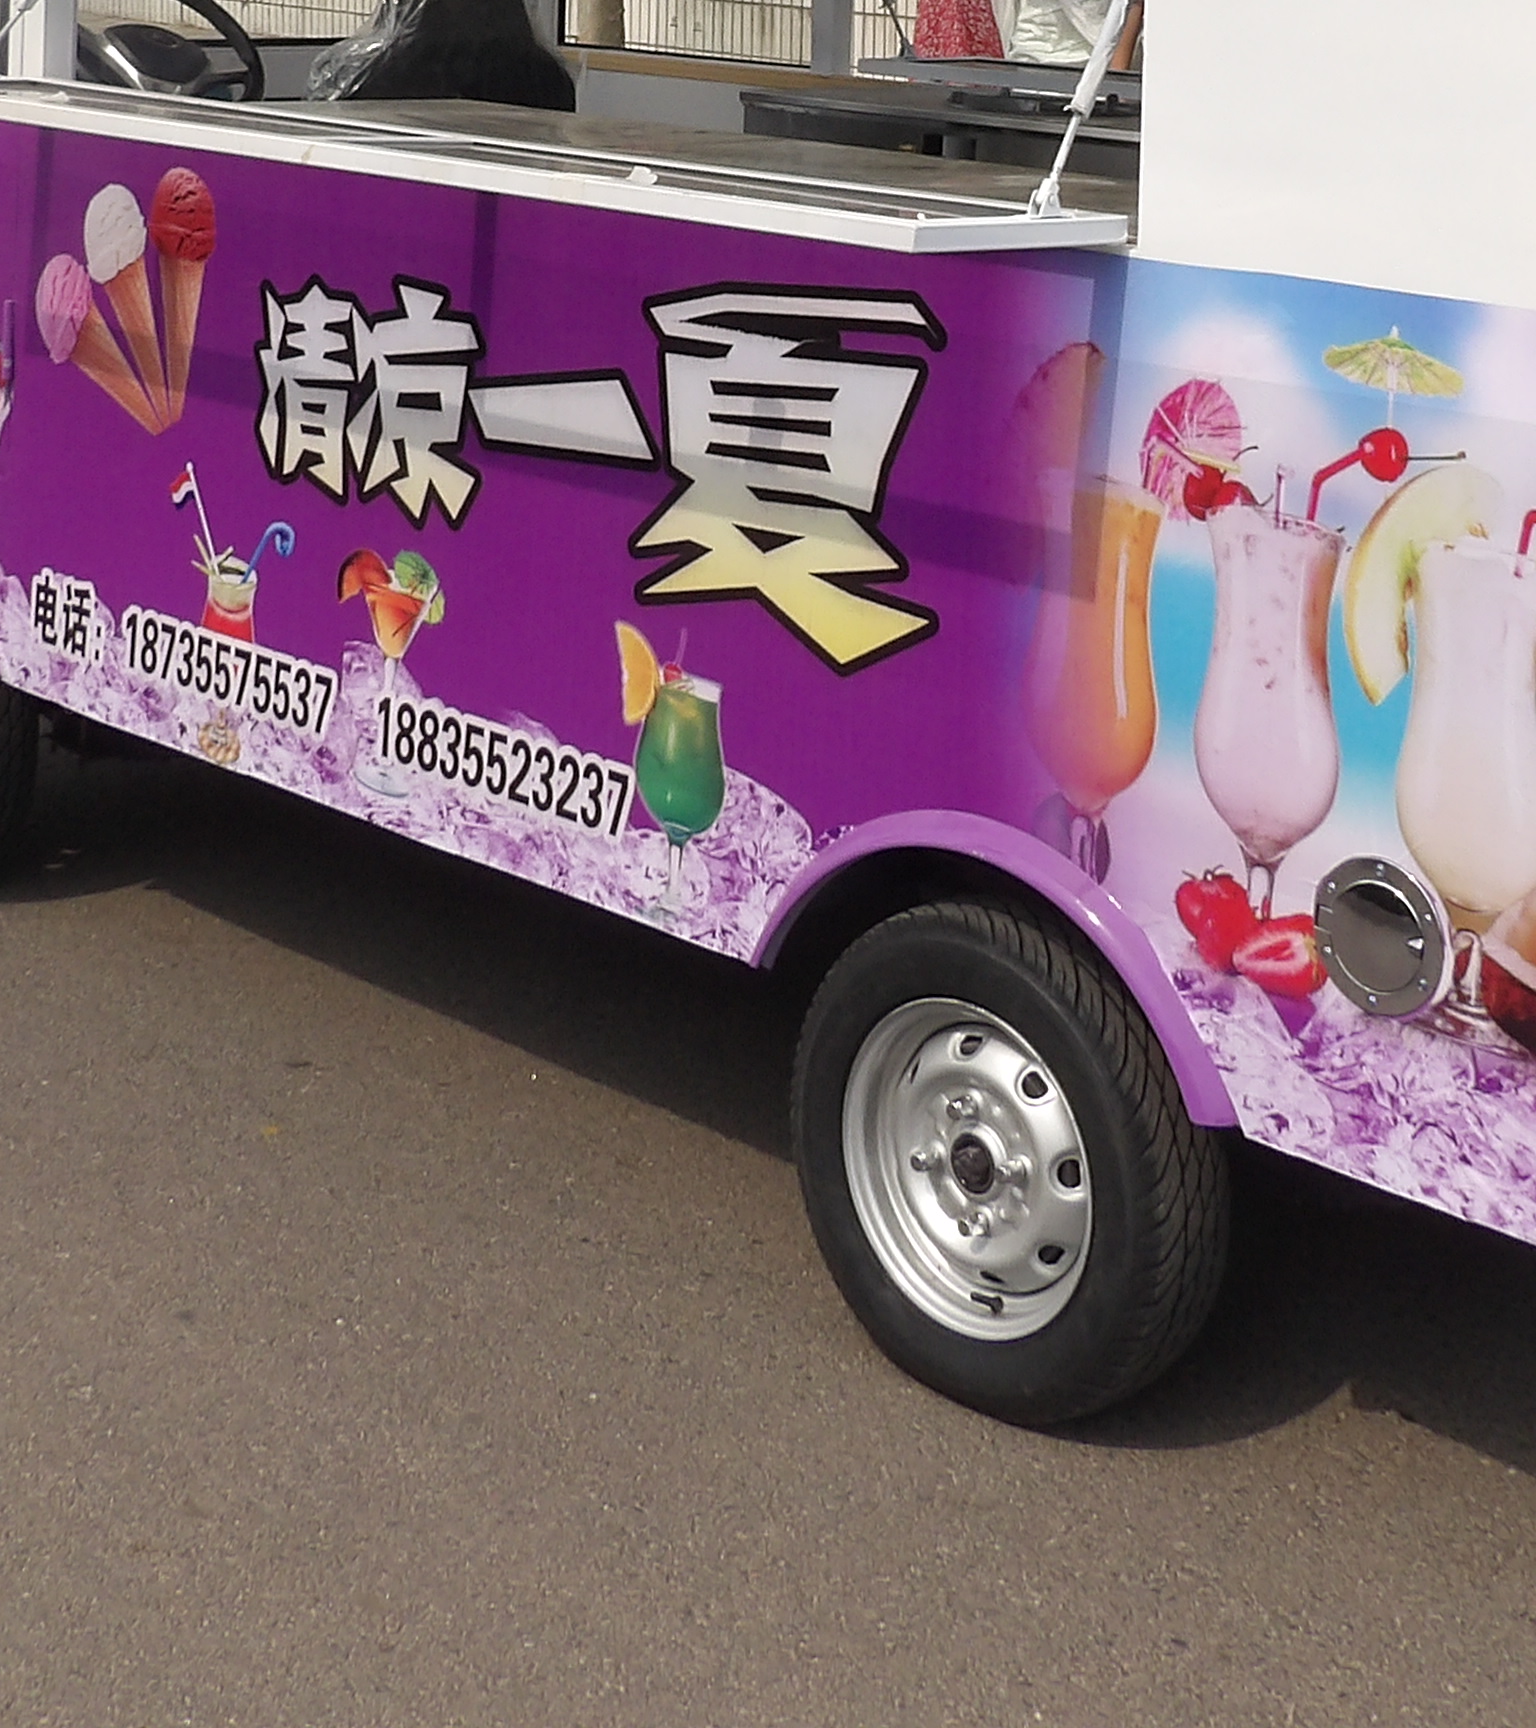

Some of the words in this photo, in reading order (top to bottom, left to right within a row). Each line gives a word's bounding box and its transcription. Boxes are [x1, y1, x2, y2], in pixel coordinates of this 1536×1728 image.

[254, 273, 948, 674] 清凉一夏
[125, 612, 334, 735] 18735575537
[377, 696, 630, 838] 18835523237
